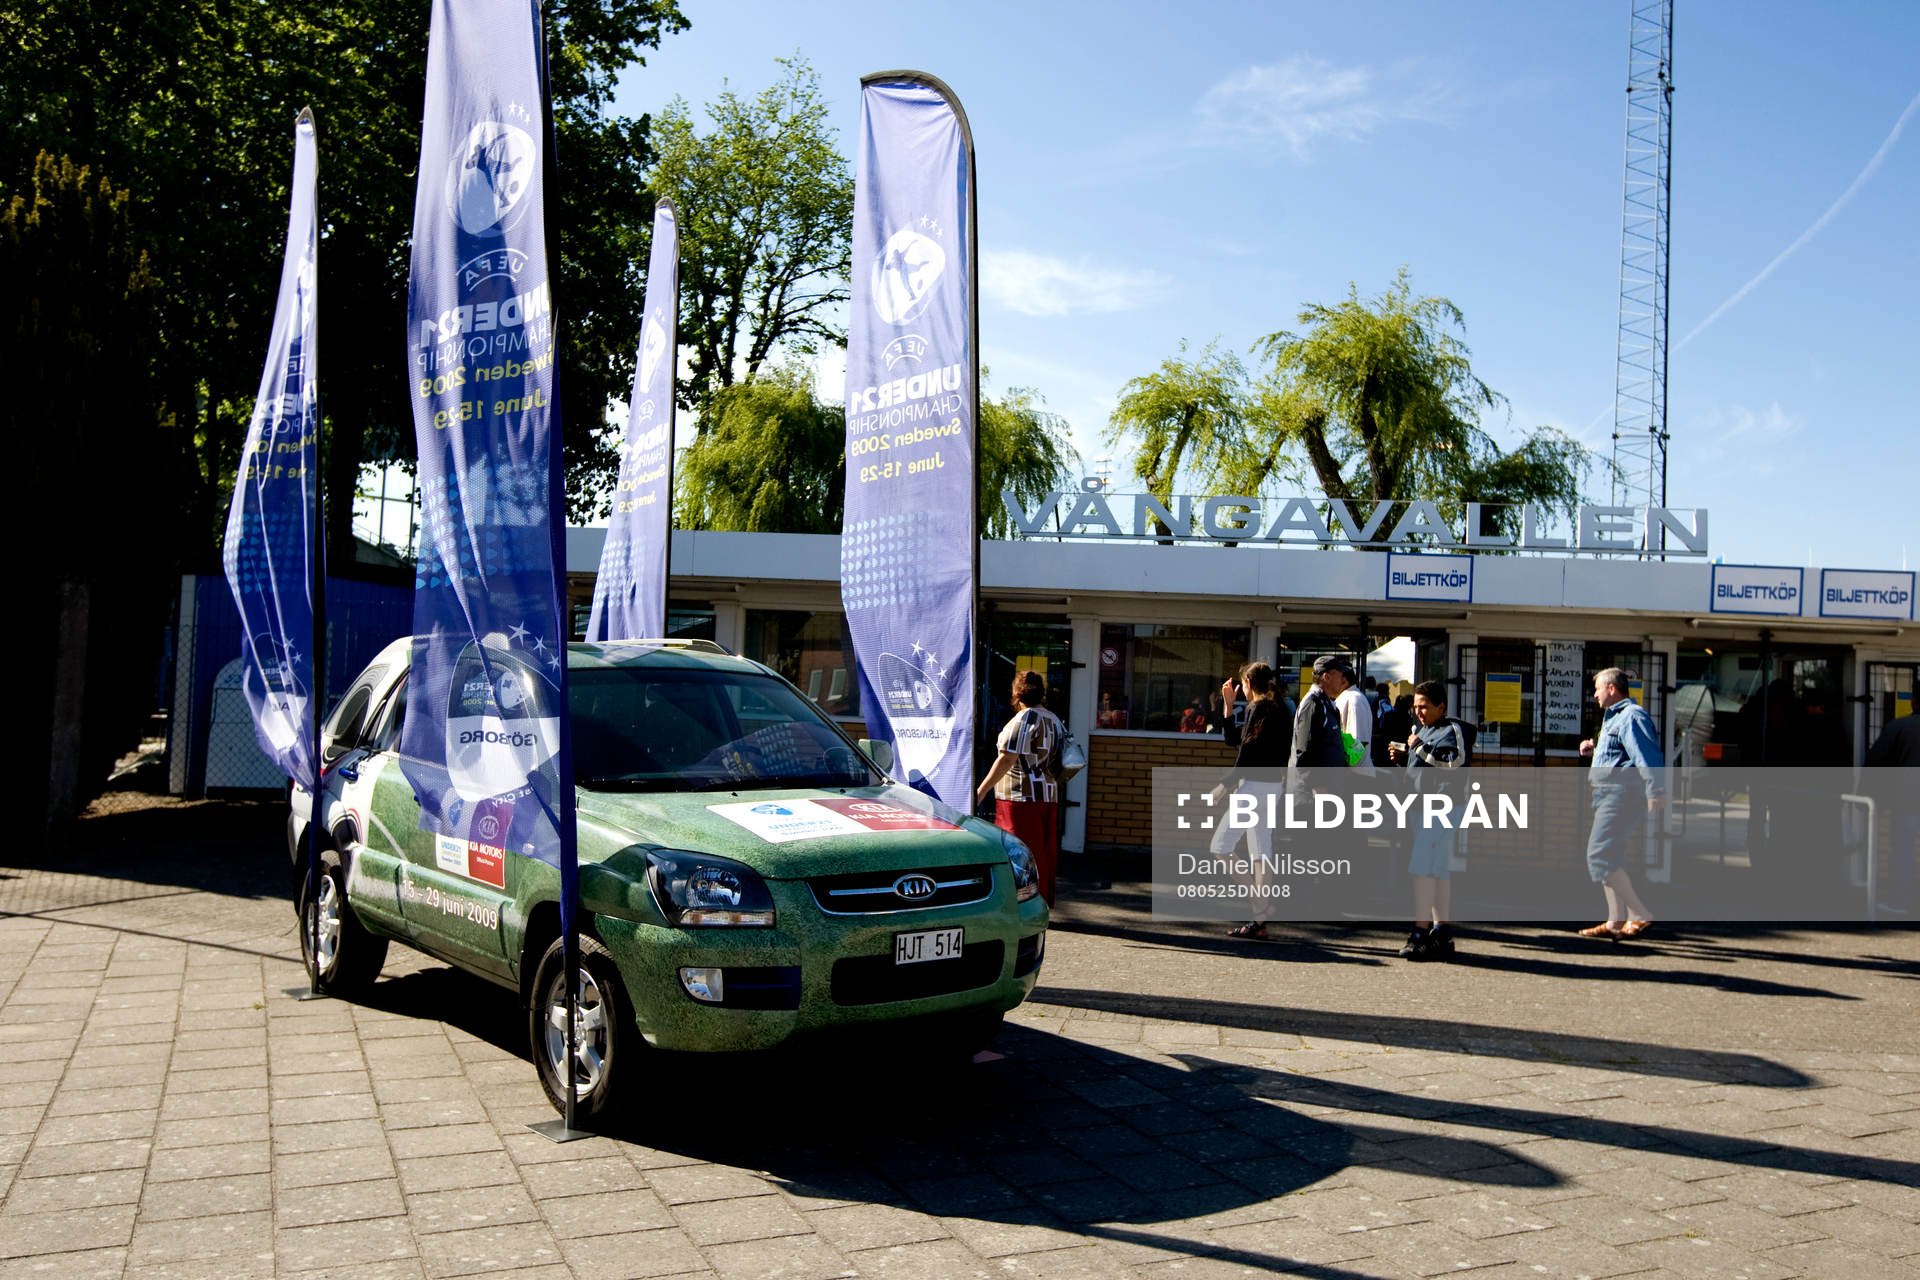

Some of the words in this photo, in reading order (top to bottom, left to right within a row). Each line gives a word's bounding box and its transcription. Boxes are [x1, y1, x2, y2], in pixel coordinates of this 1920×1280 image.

[1001, 476, 1708, 552] VÅNGAVALLEN
[1392, 569, 1468, 588] BILJETTKÖP
[1717, 582, 1797, 600] BILJETTKÖP
[1826, 586, 1909, 604] BILJETTKÖP
[1544, 713, 1577, 721] NGDOM
[904, 880, 932, 895] KIA
[403, 880, 415, 898] 15
[426, 887, 440, 908] 29
[443, 892, 464, 918] juni
[467, 903, 498, 930] 2009
[898, 936, 924, 961] HJT
[935, 931, 962, 957] 514
